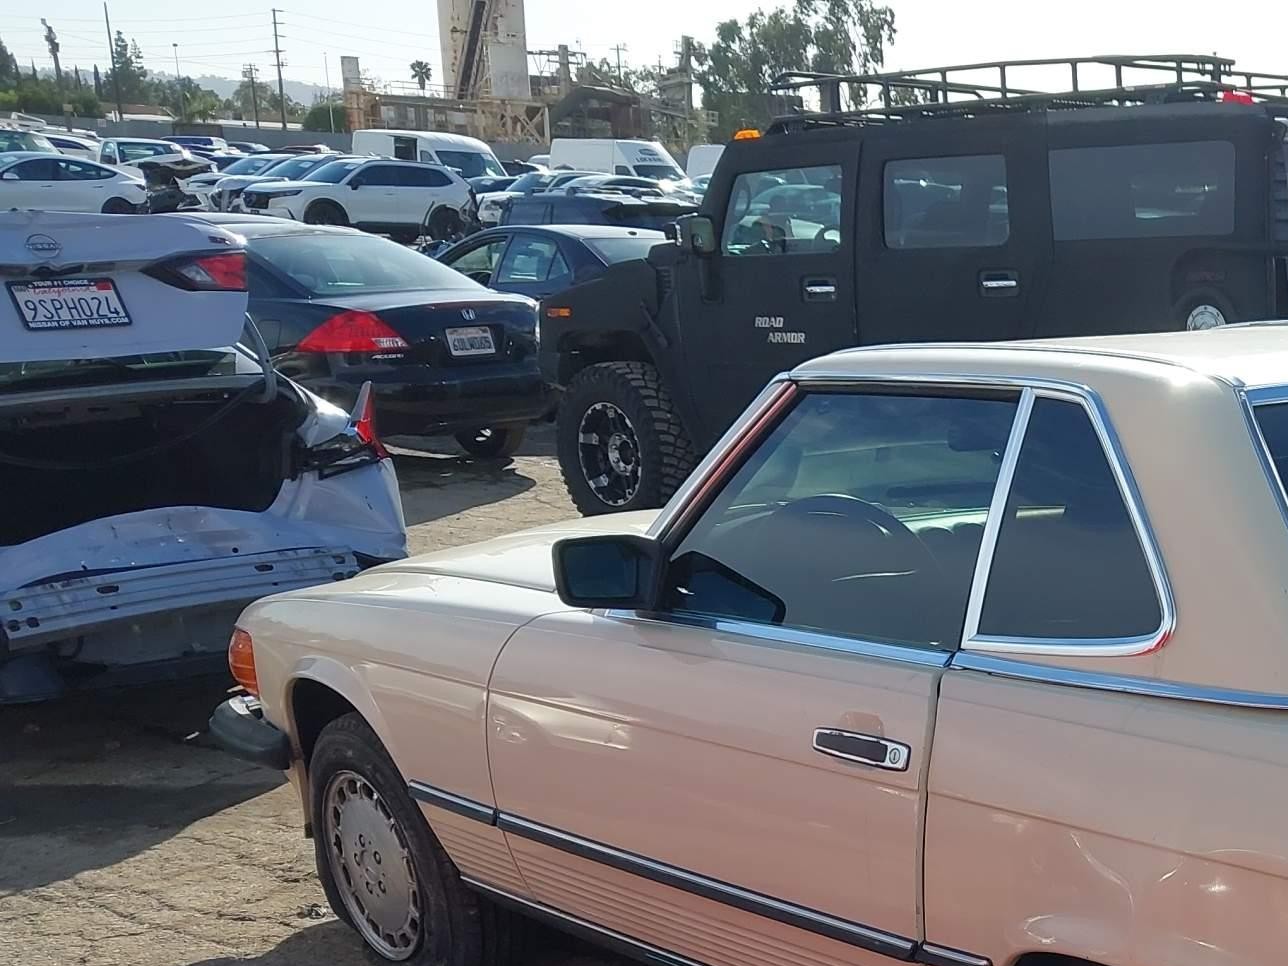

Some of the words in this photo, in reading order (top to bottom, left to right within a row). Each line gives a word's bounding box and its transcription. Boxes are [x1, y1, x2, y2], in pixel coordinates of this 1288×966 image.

[24, 296, 121, 321] 9SPH024
[755, 316, 784, 328] ROAD
[768, 332, 806, 344] ARMOR
